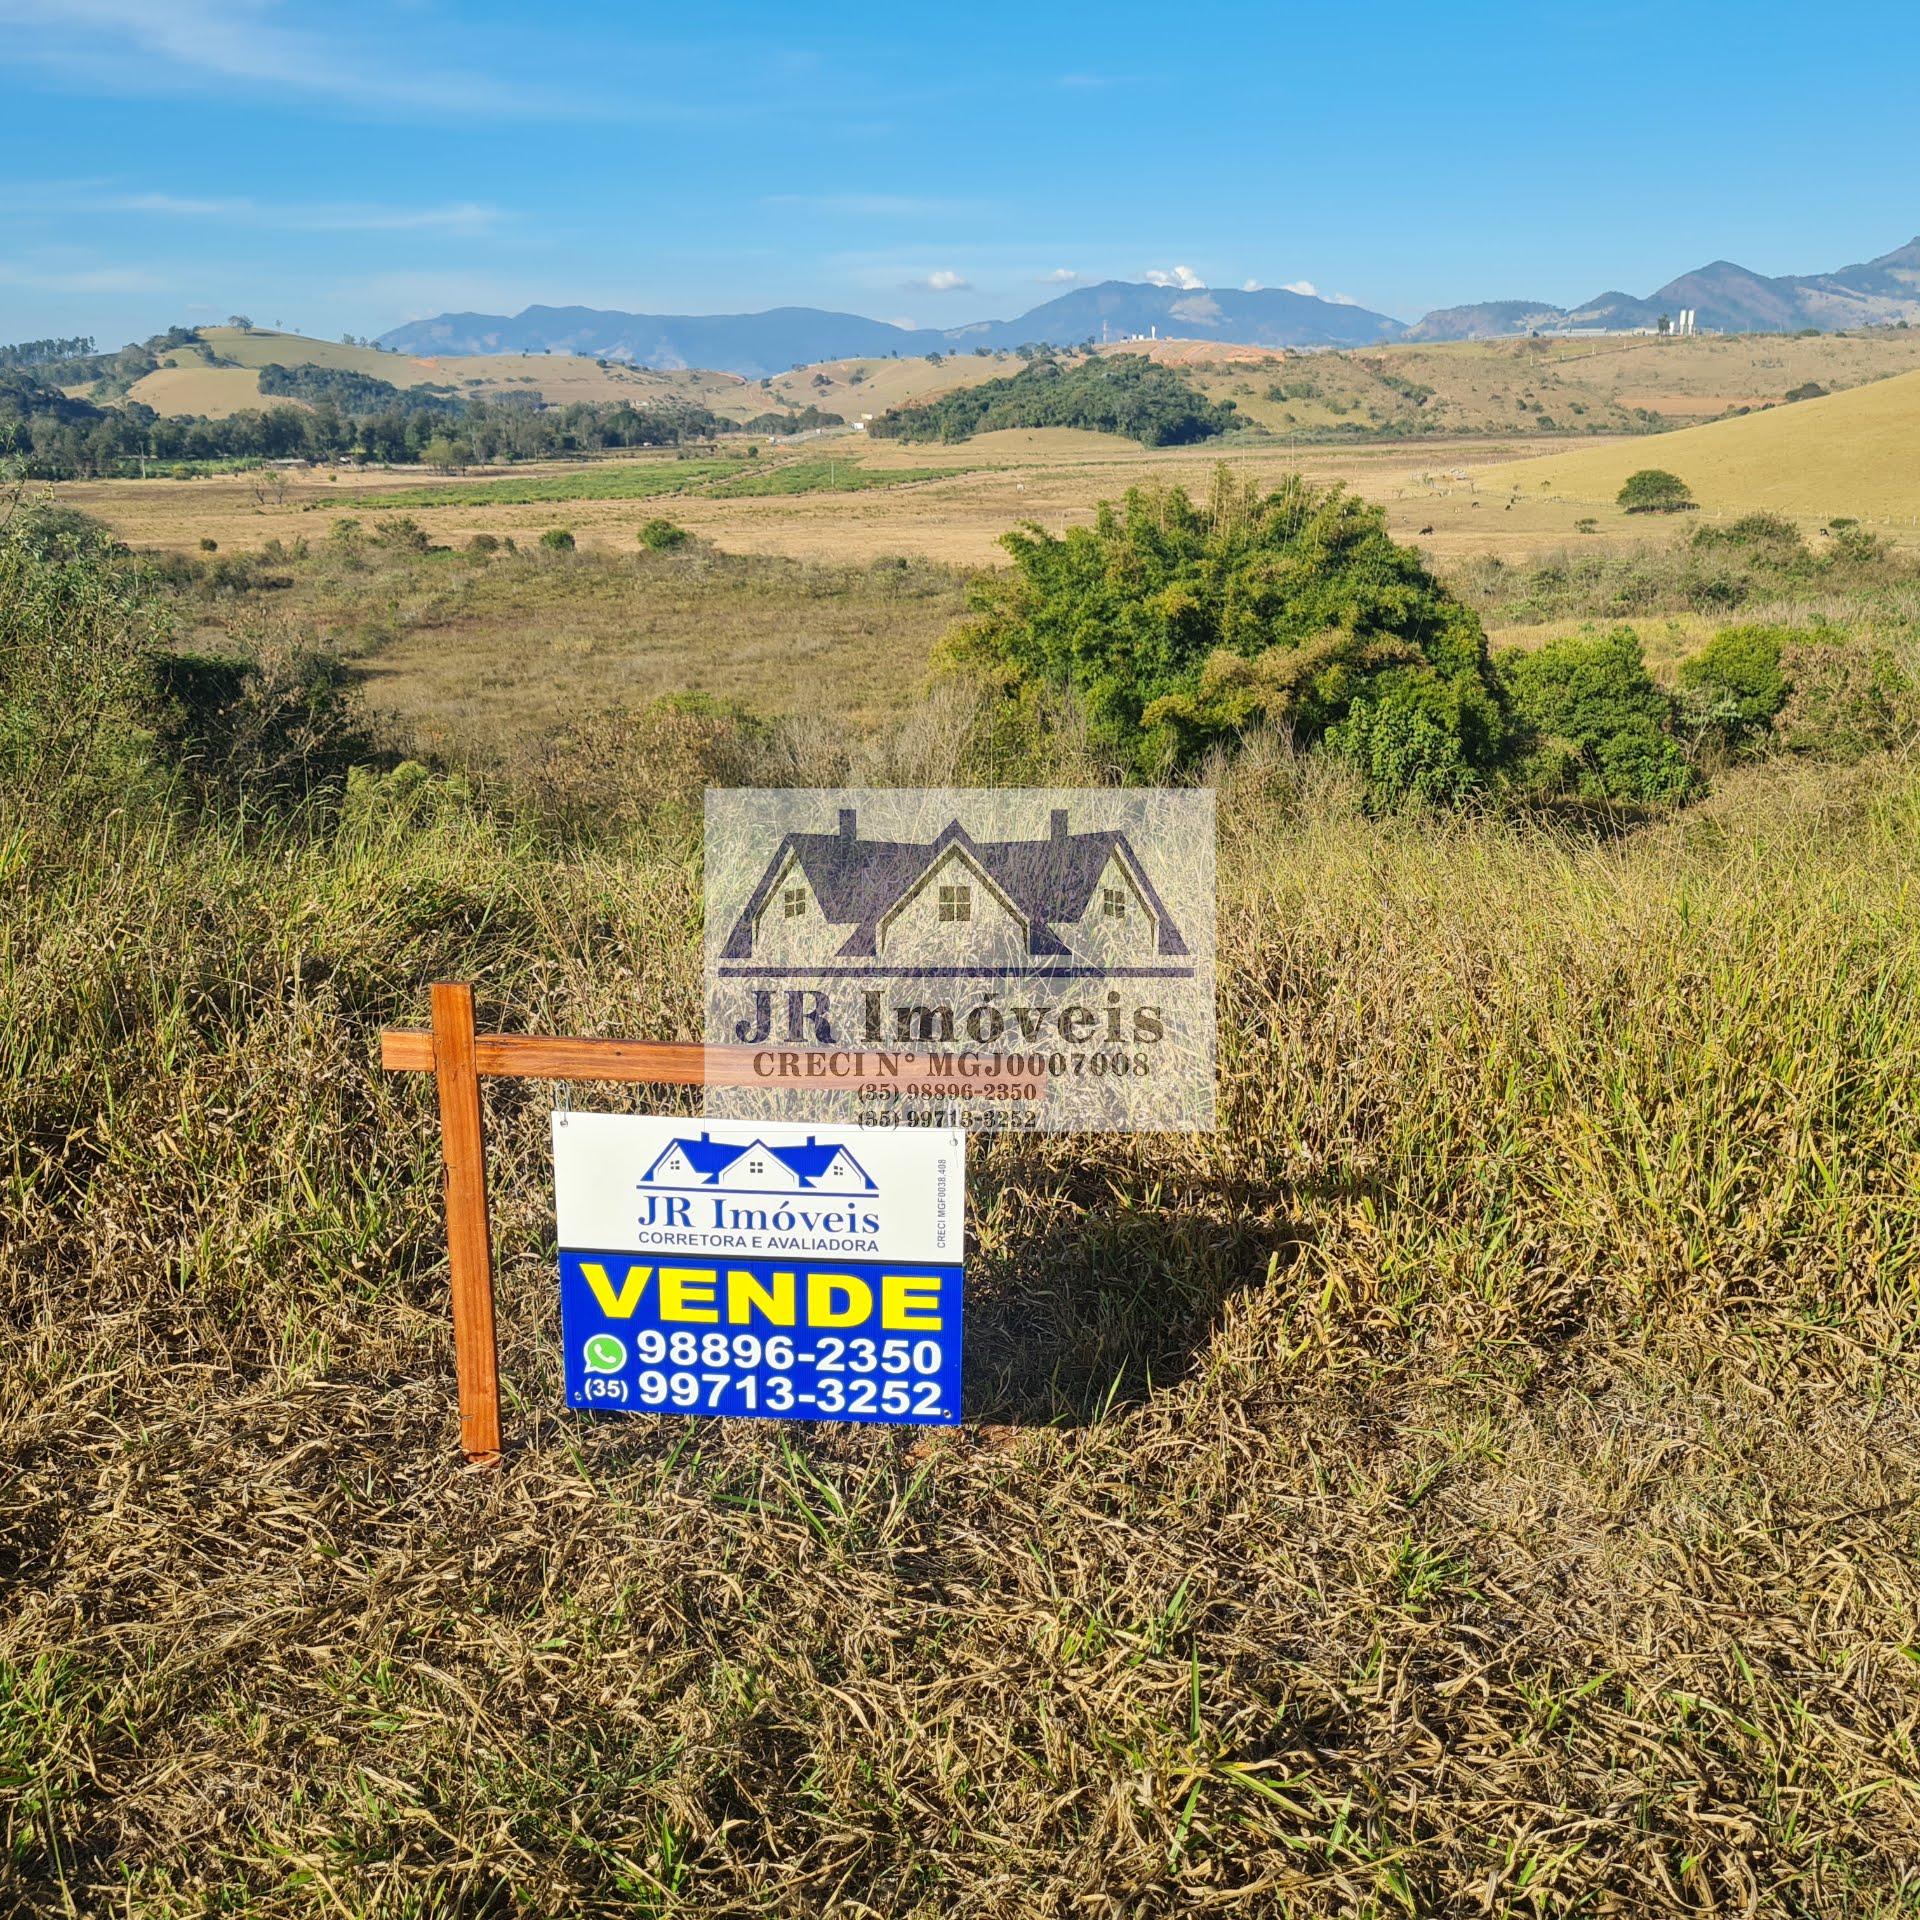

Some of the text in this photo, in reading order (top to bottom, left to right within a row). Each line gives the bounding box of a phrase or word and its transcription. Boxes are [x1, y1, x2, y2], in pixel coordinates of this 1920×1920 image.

[637, 1195, 880, 1234] JR Imóveis
[936, 1159, 947, 1249] CRECI MGF0038.408
[638, 1231, 880, 1252] CORRETORA E AVALIADORA
[578, 1262, 942, 1331] VENDE
[637, 1330, 943, 1375] 98896-2350
[584, 1374, 943, 1416] (35) 99713-3252
